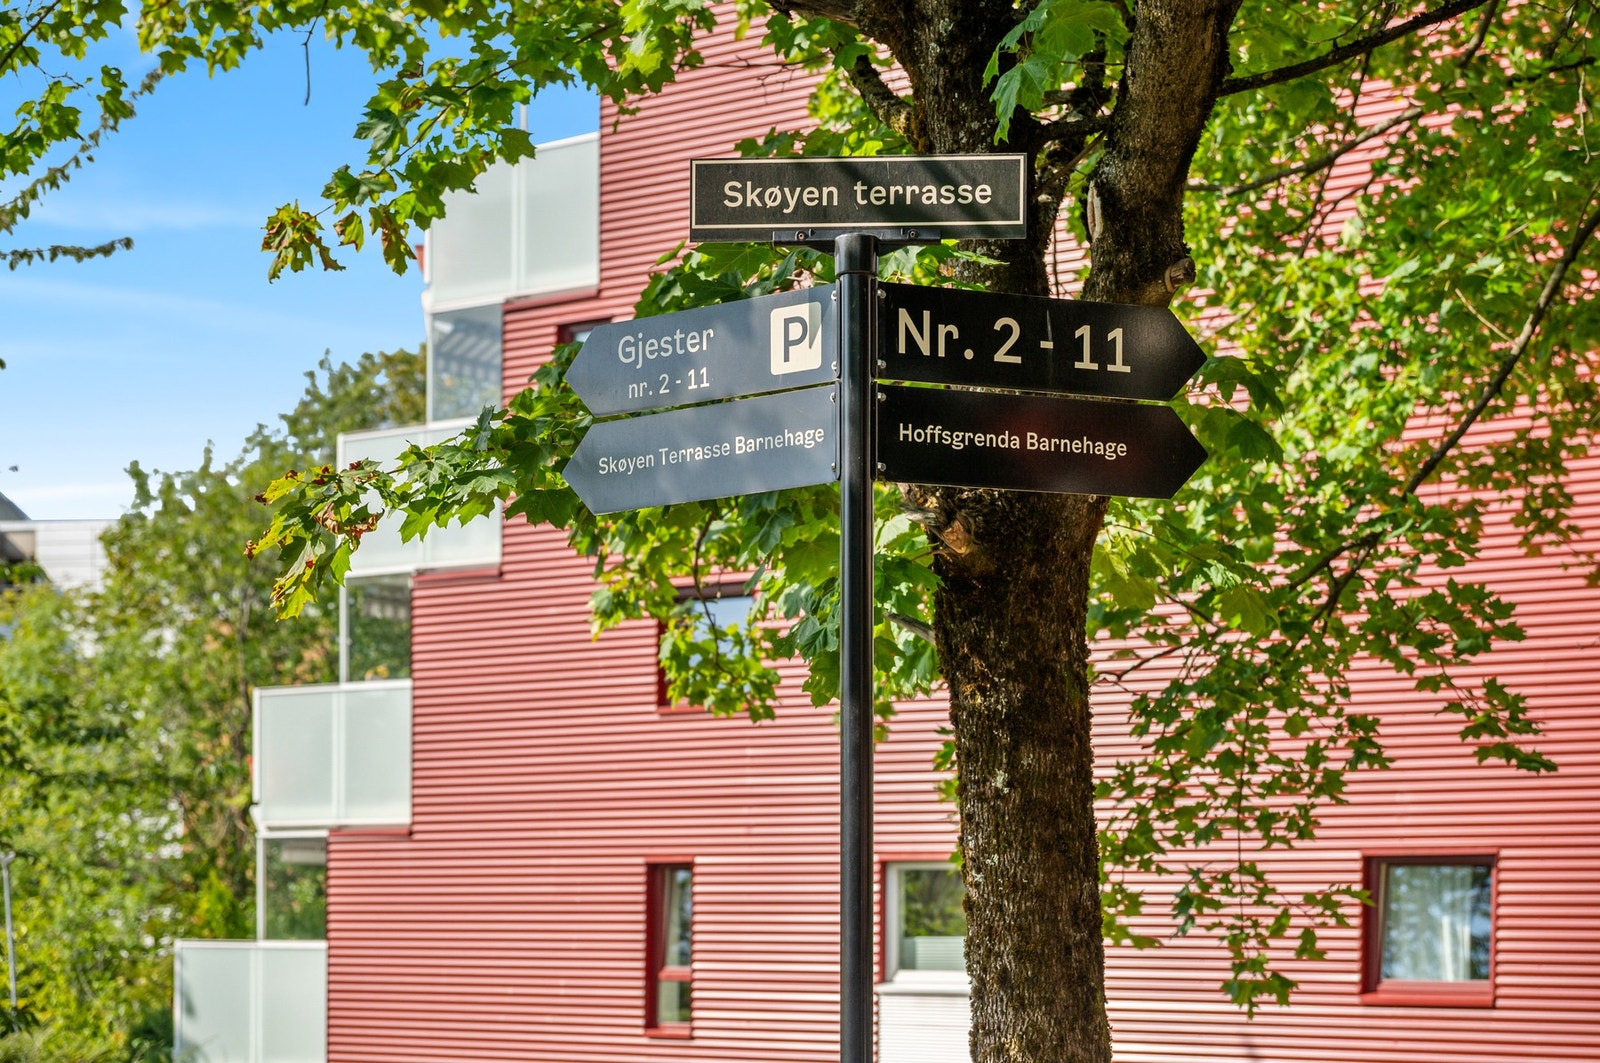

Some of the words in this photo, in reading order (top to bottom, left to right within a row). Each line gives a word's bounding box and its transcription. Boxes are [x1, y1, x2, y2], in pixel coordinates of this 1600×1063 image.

[723, 180, 838, 214] Skøyen
[853, 180, 992, 206] terrasse
[617, 326, 715, 370] Gjester
[897, 307, 974, 360] Nr.
[993, 316, 1023, 364] 2
[1074, 324, 1132, 374] 11
[628, 381, 653, 399] nr.
[659, 374, 670, 395] 2
[687, 367, 710, 391] 11
[598, 455, 654, 476] Skøyen
[658, 442, 731, 466] Terrasse
[735, 427, 825, 455] Barnehage
[899, 422, 1020, 450] Hoffsgrenda
[1026, 431, 1127, 461] Barnehage
